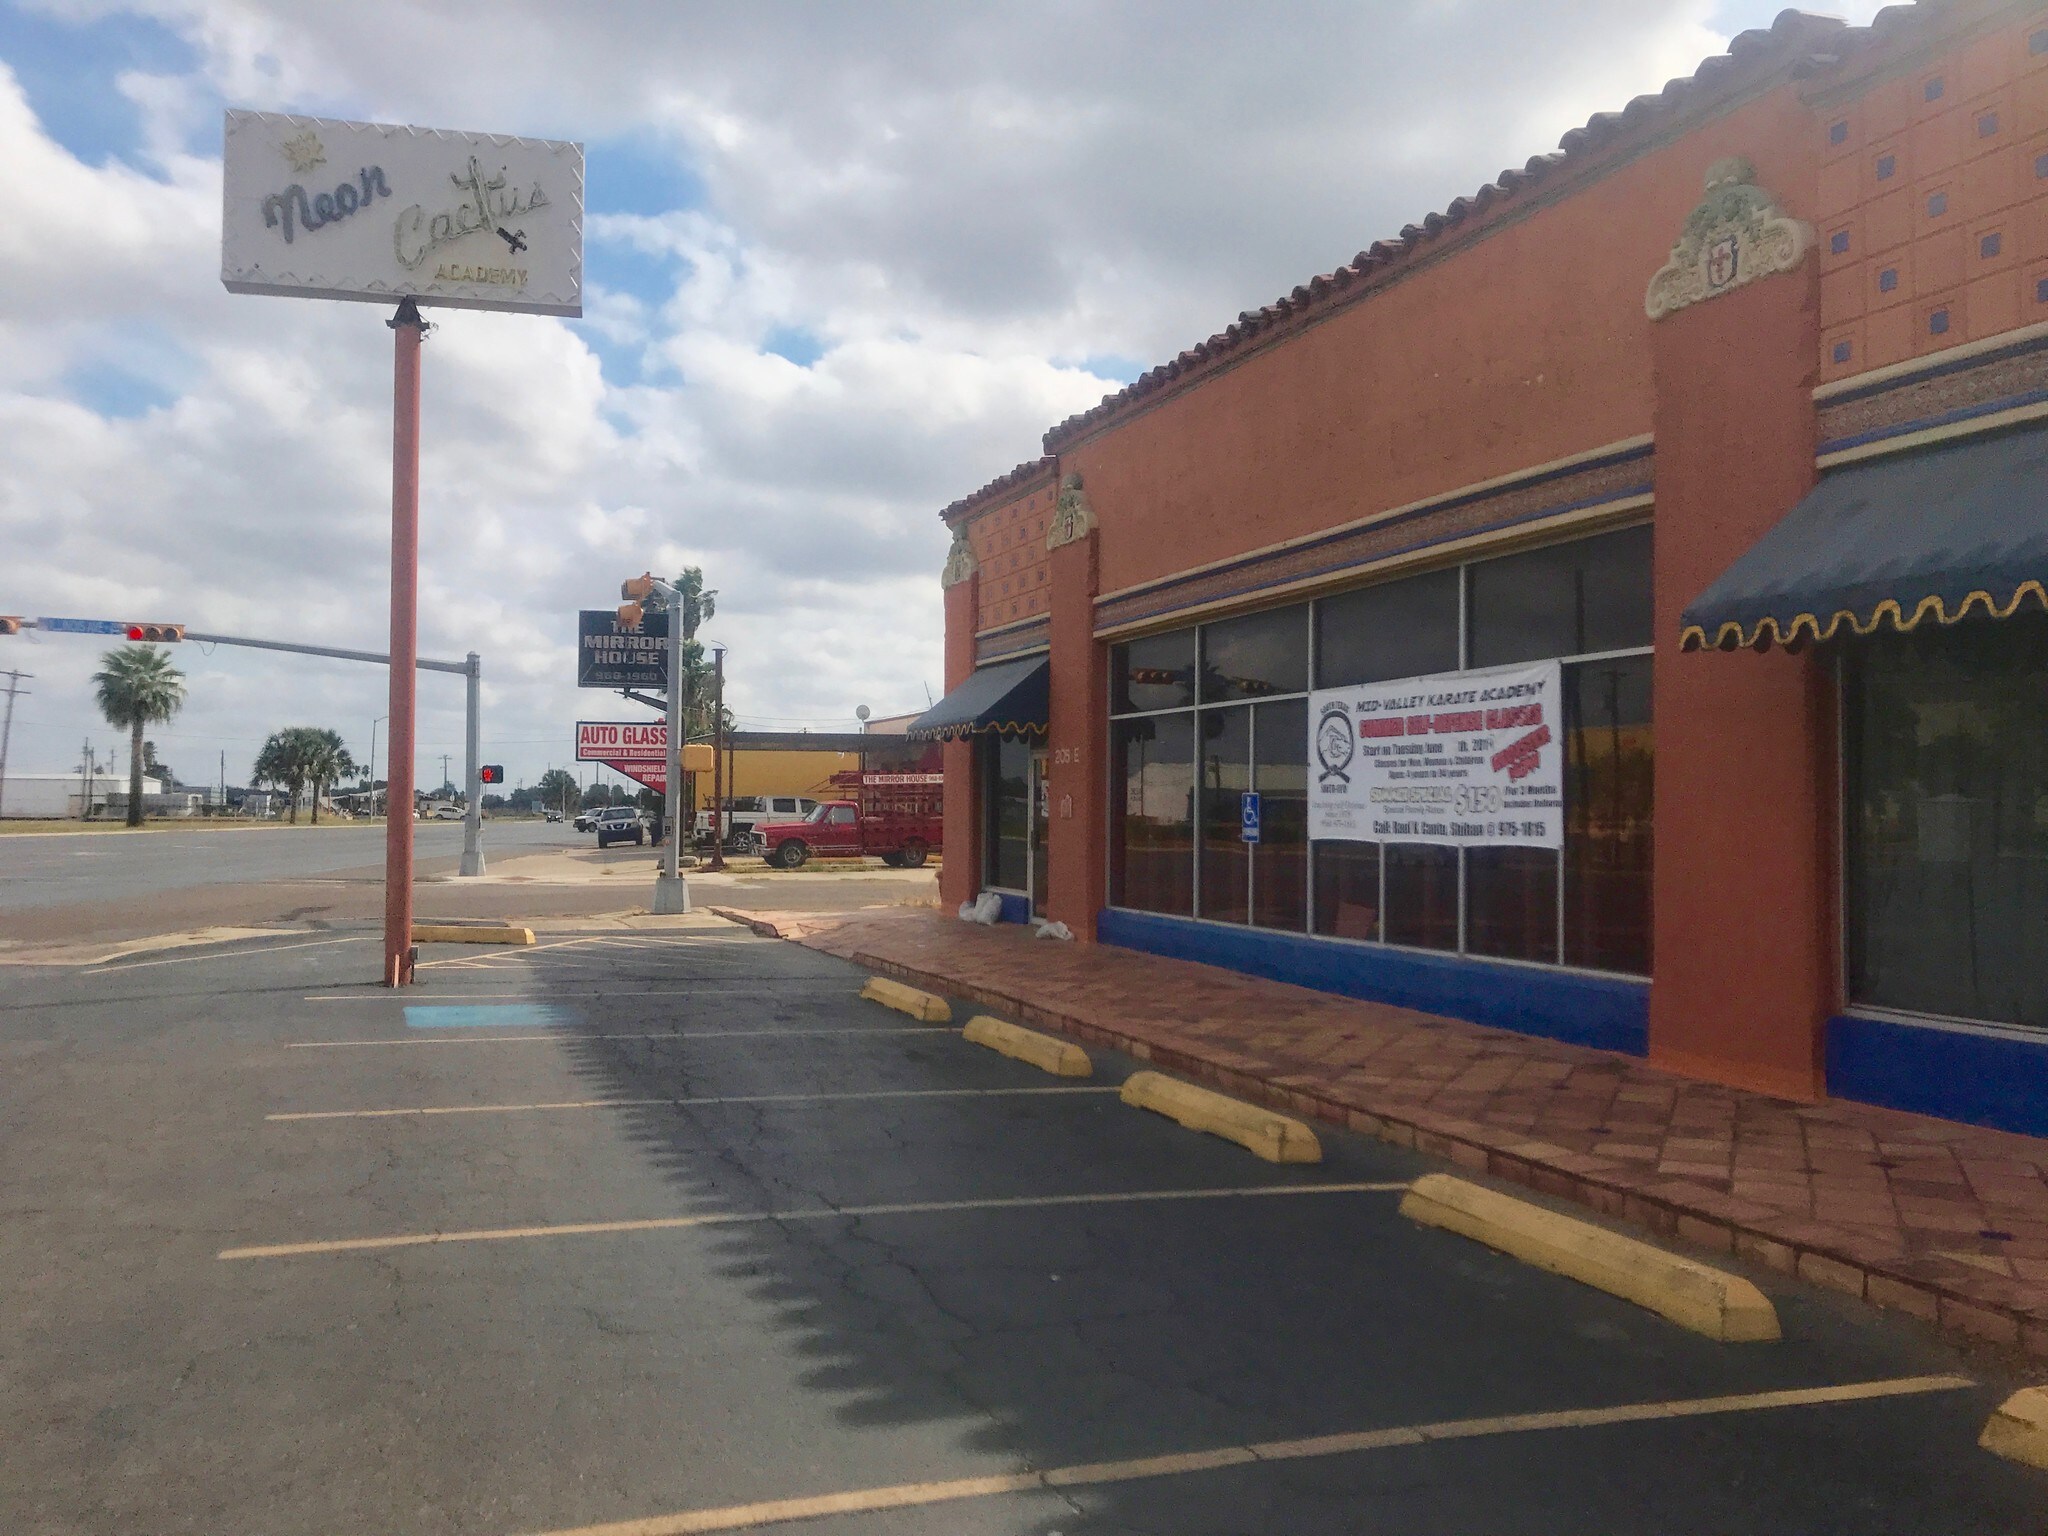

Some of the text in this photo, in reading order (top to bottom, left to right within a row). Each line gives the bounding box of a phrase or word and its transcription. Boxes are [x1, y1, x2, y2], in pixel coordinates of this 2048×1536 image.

[261, 165, 392, 244] Neon
[393, 156, 553, 270] Cactus
[435, 264, 528, 287] ACADEMY
[584, 635, 668, 650] MIRROR
[594, 650, 659, 665] HOUSE
[1356, 680, 1545, 712] MID-VALLEY KARATE ACADEMY
[580, 726, 667, 745] AUTO GLASS
[582, 748, 666, 757] Commercial & Residential
[624, 764, 666, 773] WINDSHIELD
[642, 774, 667, 782] REPAIR
[878, 775, 904, 783] MIRROR
[906, 775, 927, 783] HOUSE
[1453, 783, 1502, 816] $150
